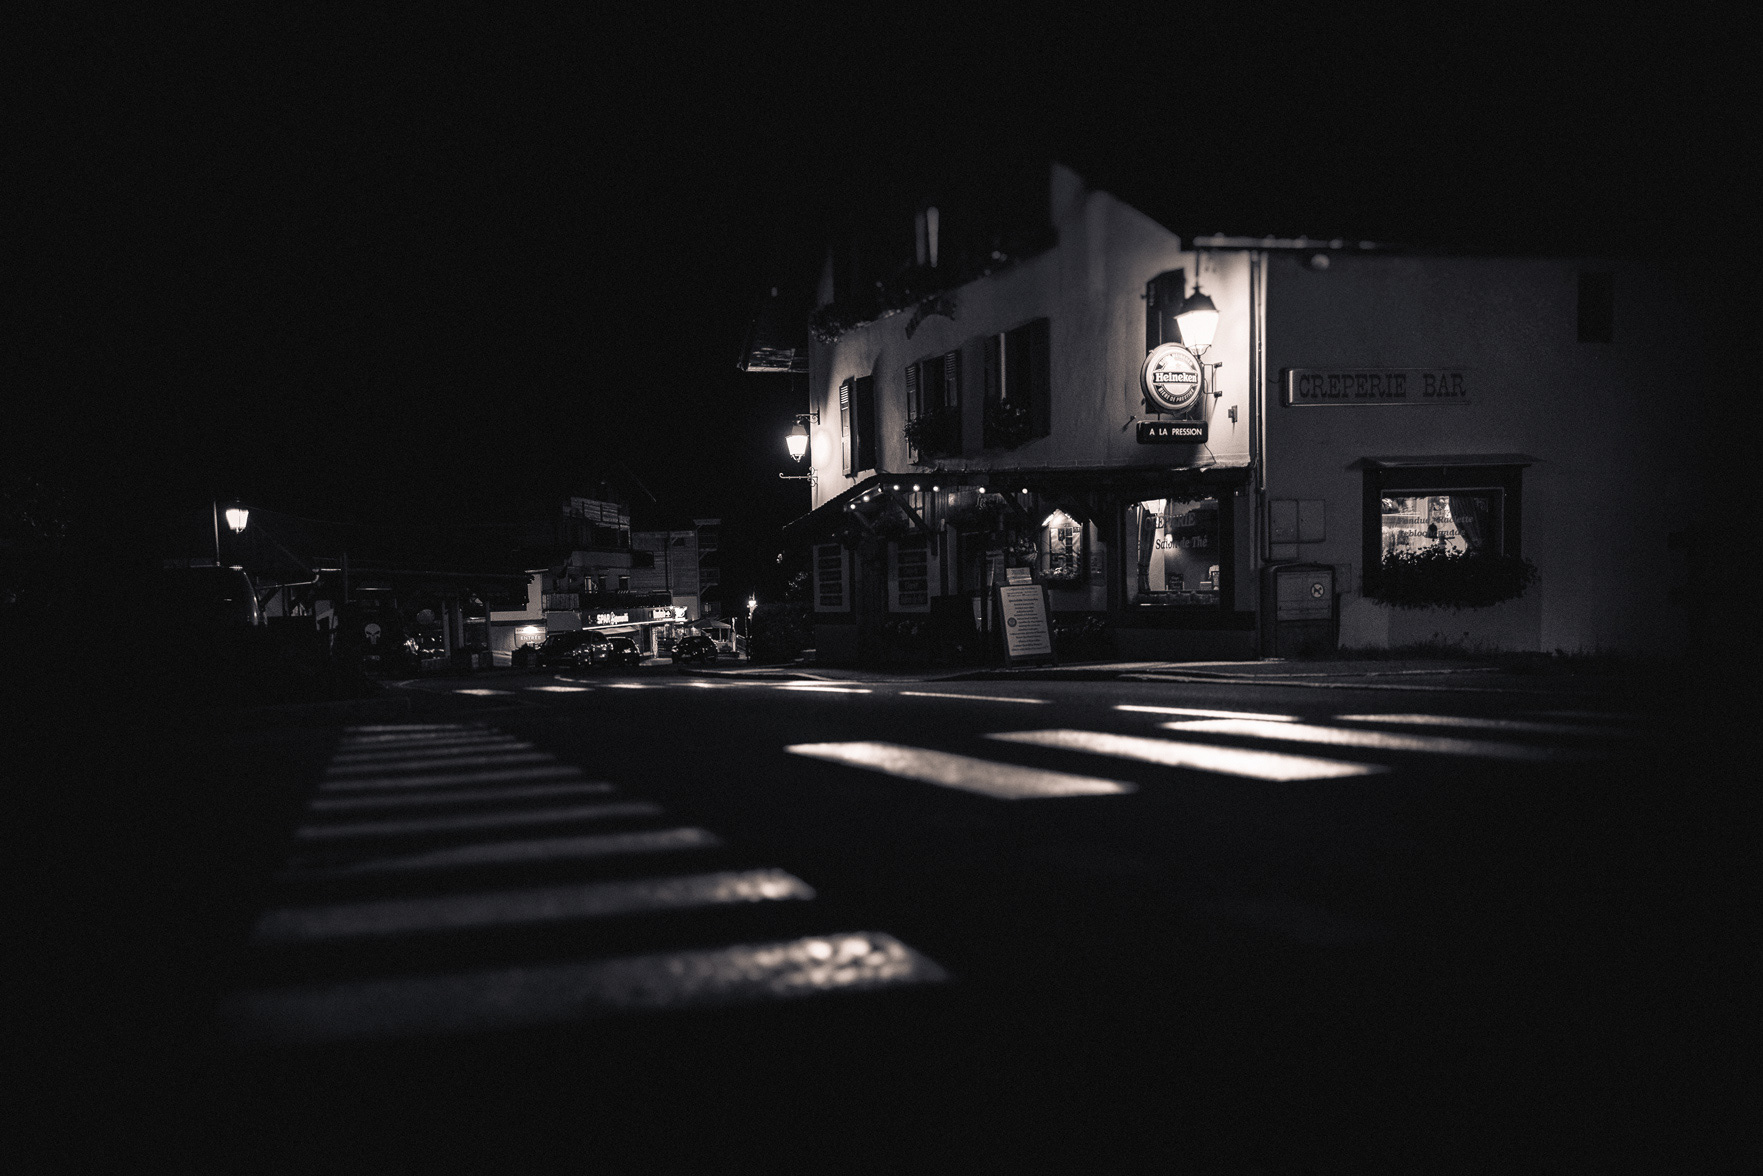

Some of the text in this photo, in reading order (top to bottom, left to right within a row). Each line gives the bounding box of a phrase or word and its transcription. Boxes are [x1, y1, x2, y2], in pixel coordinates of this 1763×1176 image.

[1155, 372, 1197, 382] Heineken
[1298, 373, 1467, 398] CREPERIE BAR
[1149, 428, 1203, 436] A LA PRESSION
[1180, 537, 1190, 548] de
[1192, 535, 1208, 548] Thé
